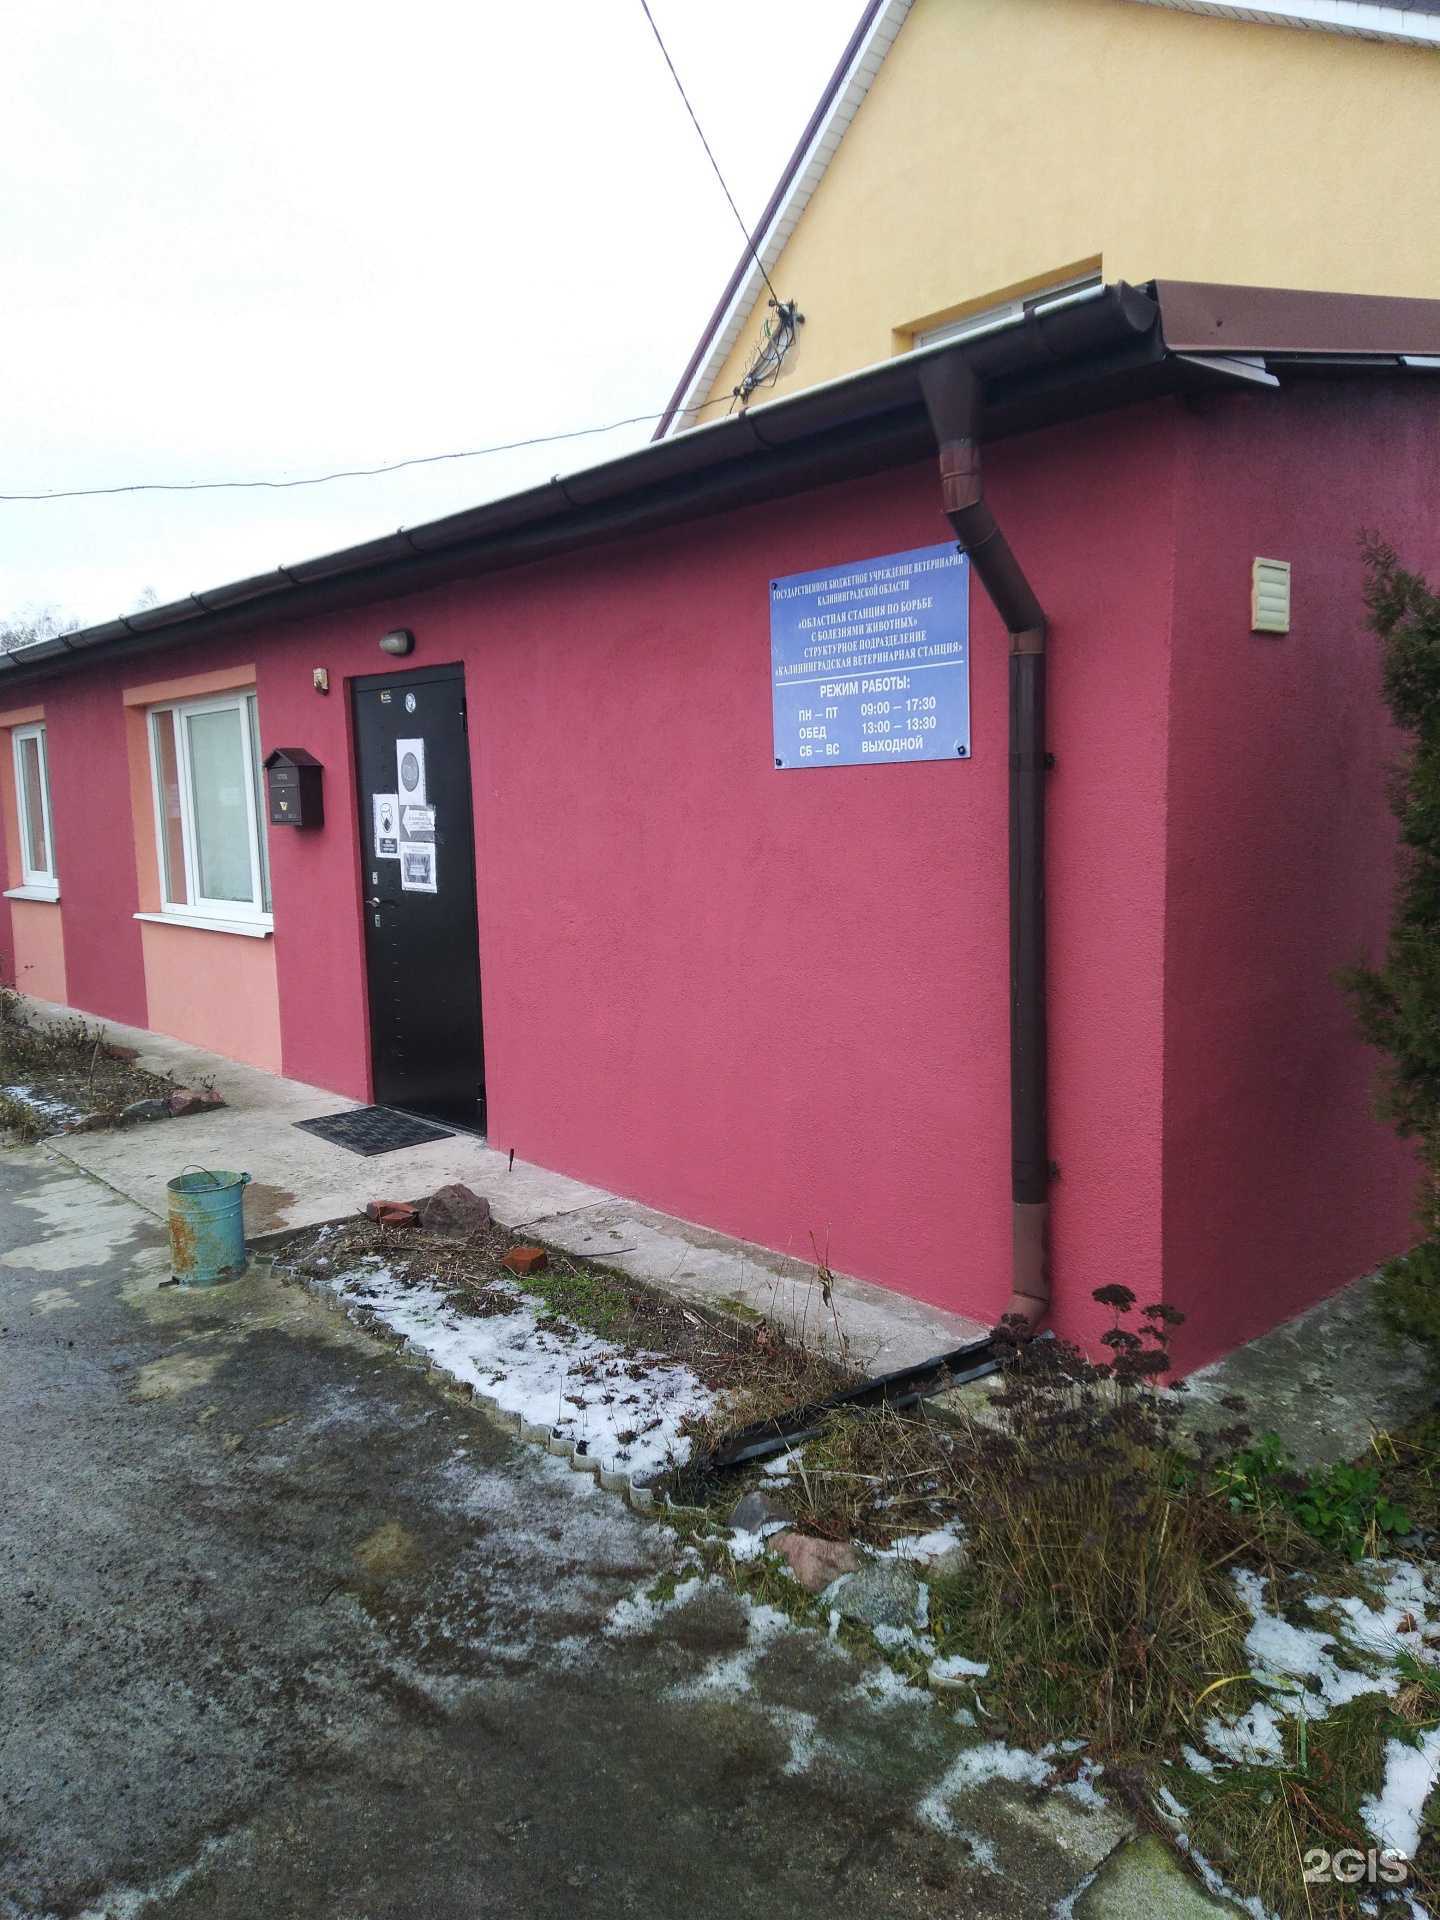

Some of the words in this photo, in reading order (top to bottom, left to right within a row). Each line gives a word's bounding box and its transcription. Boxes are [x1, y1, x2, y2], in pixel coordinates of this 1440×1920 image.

[774, 583, 828, 600] ГОСУДАРСТВЕННОЕ
[828, 573, 868, 590] БЮДЖЕТНОЕ
[869, 564, 912, 580] УЧРЕЖДЕНИЕ
[914, 554, 963, 572] ВЕТЕРИНАРИИ
[817, 584, 878, 606] КАЛИНИНГРАДСКОЙ
[879, 580, 910, 595] ОБЛАСТИ
[848, 604, 886, 622] СТАНЦИЯ
[888, 603, 898, 614] ПО
[901, 597, 934, 612] БОРЬБЕ
[804, 640, 858, 658] СТРУКТУРНОЕ
[860, 631, 926, 651] ПОДРАЗДЕЛЕНИЕ
[811, 632, 817, 642] С
[818, 624, 864, 640] БОЛЕЗНЯМИ
[853, 648, 916, 666] ВЕТЕРИНАРНАЯ
[820, 682, 858, 698] РЕЖИМ
[862, 675, 911, 693] РАБОТЫ:
[799, 709, 811, 720] ПН
[826, 707, 838, 718] ПТ
[860, 701, 890, 716] 09:00
[906, 696, 936, 712] 17:30
[800, 726, 827, 740] ОБЕД
[862, 720, 890, 734] 13:00
[906, 716, 936, 730] 13:30
[800, 745, 812, 757] СБ
[826, 742, 840, 755] ВС
[862, 734, 924, 752] ВЫХОДНОЙ
